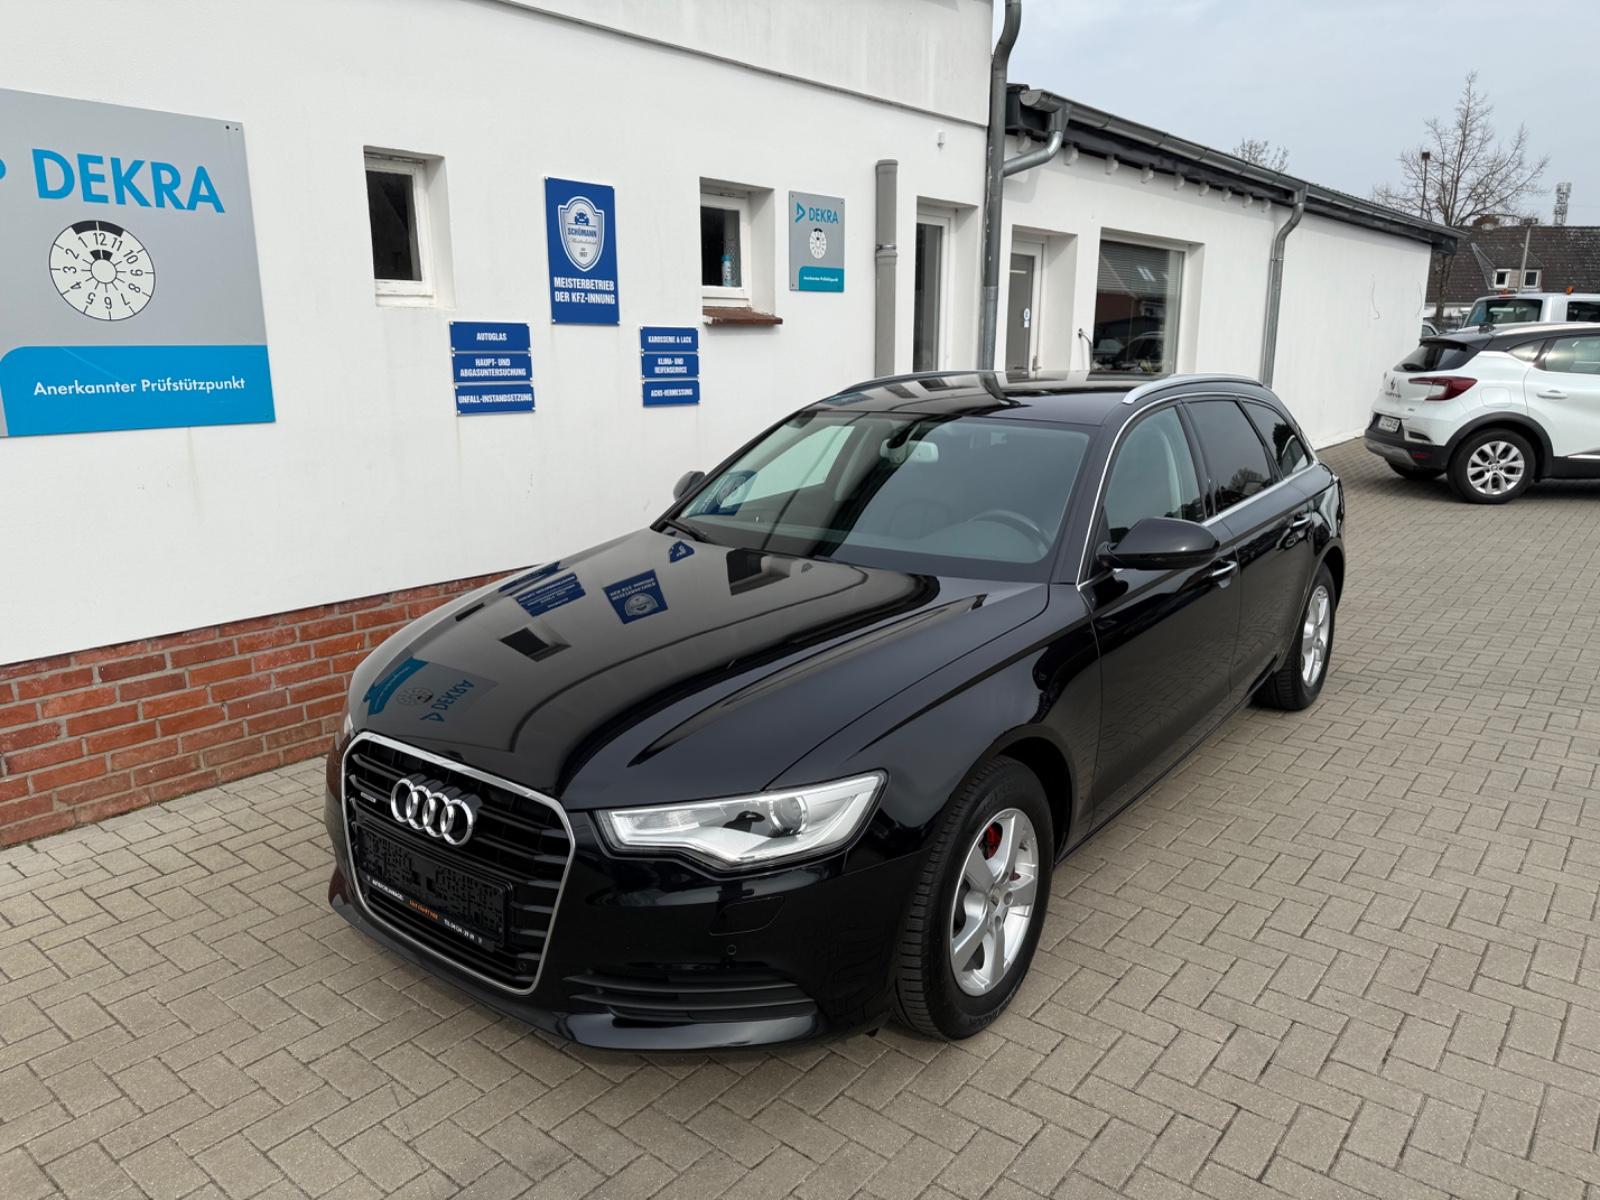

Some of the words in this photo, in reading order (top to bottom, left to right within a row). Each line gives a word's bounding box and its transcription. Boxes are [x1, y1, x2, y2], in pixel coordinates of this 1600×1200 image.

[32, 148, 225, 214] DEKRA
[808, 207, 839, 224] DEKRA
[78, 236, 88, 249] 1
[93, 232, 108, 246] 12
[111, 236, 123, 252] 11
[65, 248, 79, 260] 2
[123, 249, 139, 265] 10
[63, 266, 77, 274] 3
[130, 268, 143, 277] 9
[70, 281, 82, 291] 4
[128, 282, 141, 294] 8
[554, 277, 615, 291] MEISTERBETRIEB
[86, 292, 96, 305] 5
[104, 296, 113, 309] 6
[120, 292, 130, 306] 7
[555, 291, 570, 303] DER
[571, 291, 616, 305] KFZ-INNUNG
[476, 332, 507, 341] AUTOGLAS
[475, 358, 497, 366] HAUPT-
[498, 358, 511, 366] UND
[460, 368, 527, 377] ABGASUNTERSUCHUNG
[33, 381, 137, 396] Anerkannter
[141, 377, 246, 394] Prüfstützpunkt
[458, 393, 533, 404] UNFALL-INSTANDSETZUNG
